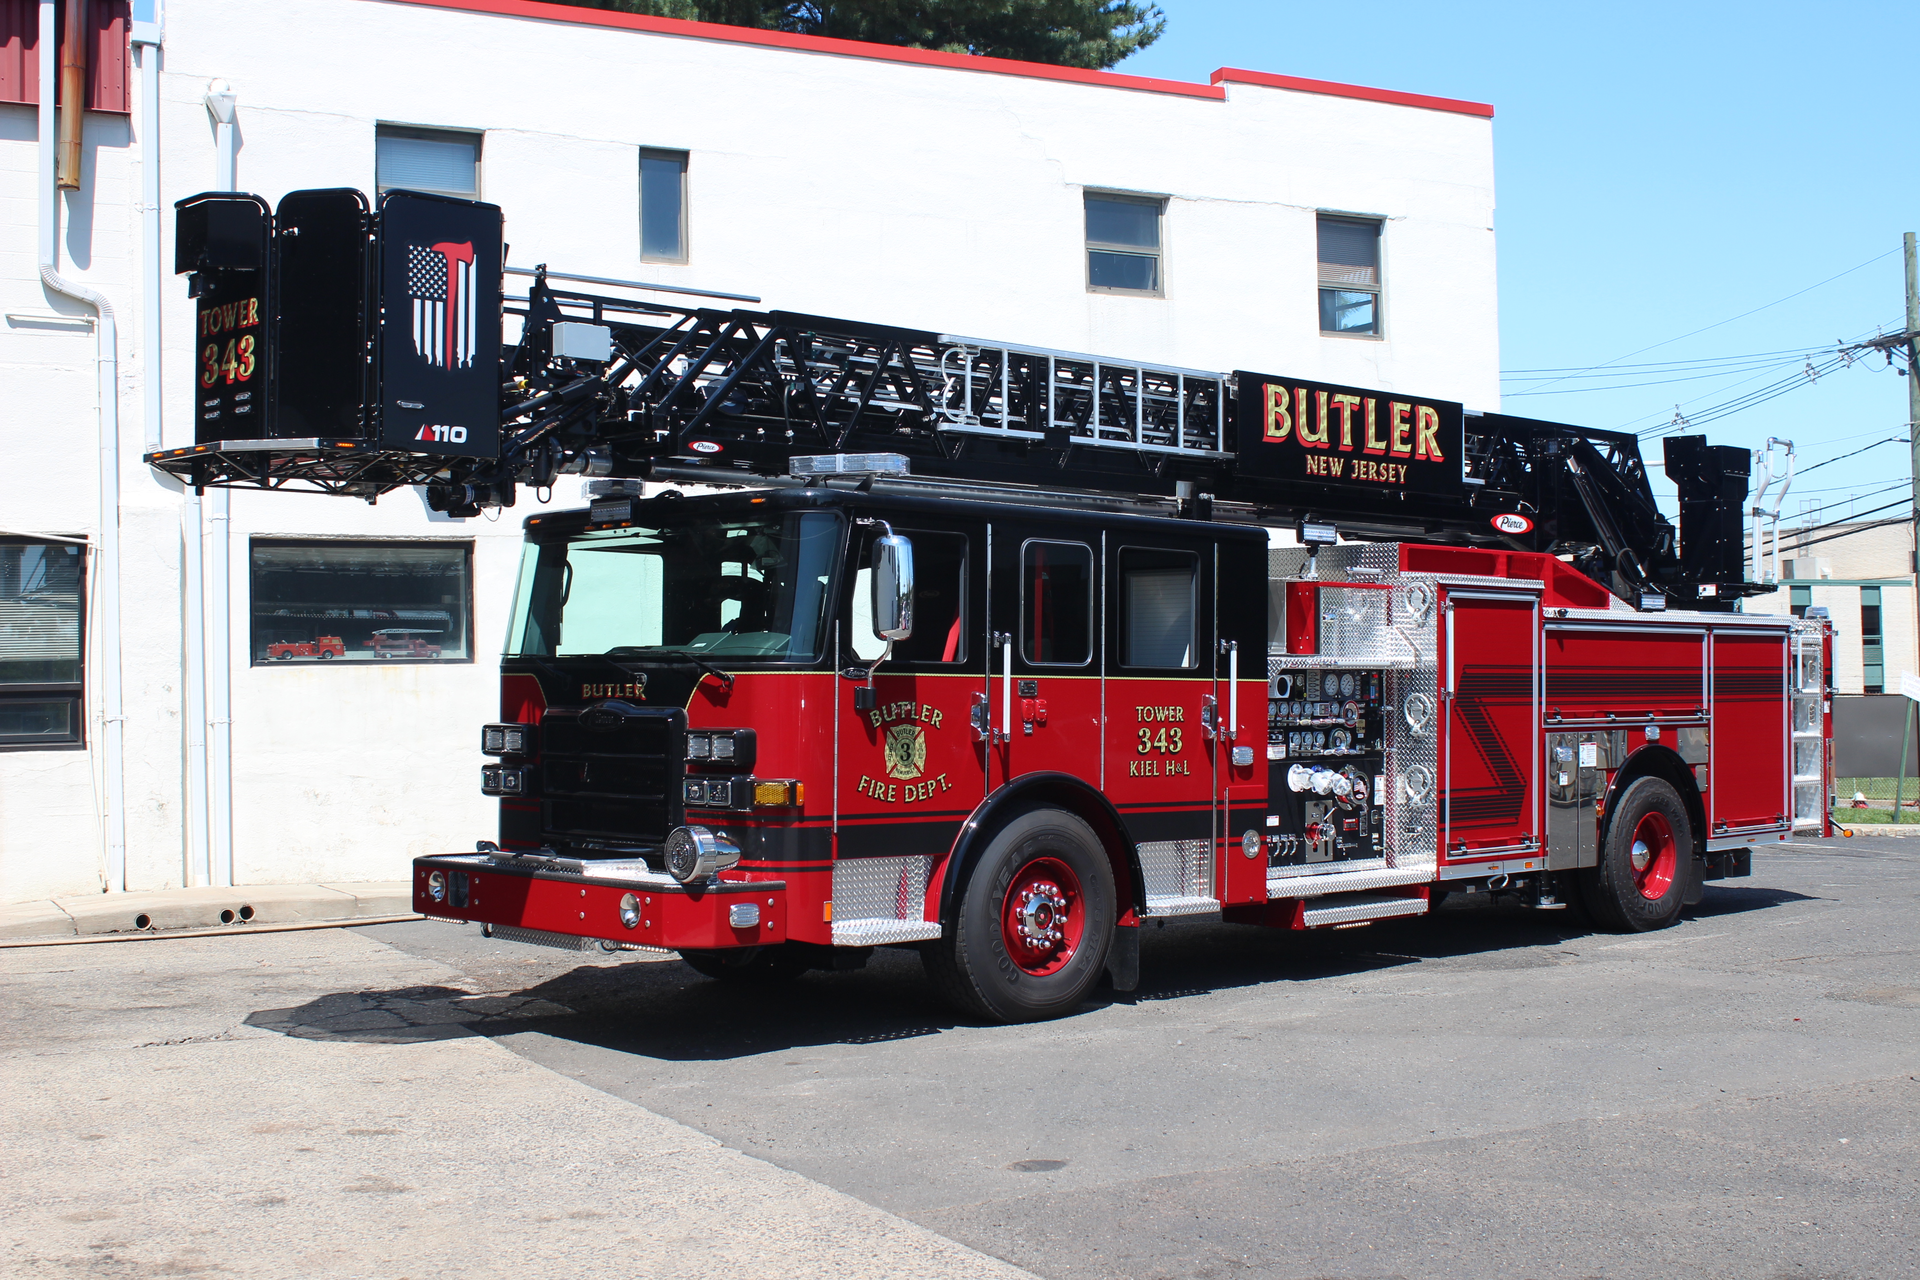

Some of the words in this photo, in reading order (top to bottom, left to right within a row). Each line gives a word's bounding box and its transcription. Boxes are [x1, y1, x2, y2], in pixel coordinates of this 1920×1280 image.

[199, 297, 259, 338] TOWER
[201, 334, 256, 389] 343
[431, 424, 468, 444] 110
[1262, 382, 1445, 463] BUTLER
[1305, 454, 1345, 478] NEW
[1350, 459, 1408, 484] JERSEY
[1500, 515, 1525, 530] Pierce
[582, 683, 647, 701] BUTLER
[869, 701, 944, 729] BUTLER
[1135, 706, 1185, 722] TOWER
[895, 727, 916, 738] BUTLER
[1137, 727, 1183, 757] 343
[900, 742, 911, 762] 3
[1129, 760, 1160, 777] KIEL
[1165, 760, 1191, 776] H&L
[856, 775, 897, 803] FIRE
[903, 772, 953, 804] DEPT.
[988, 838, 1036, 986] GOODYEAR
